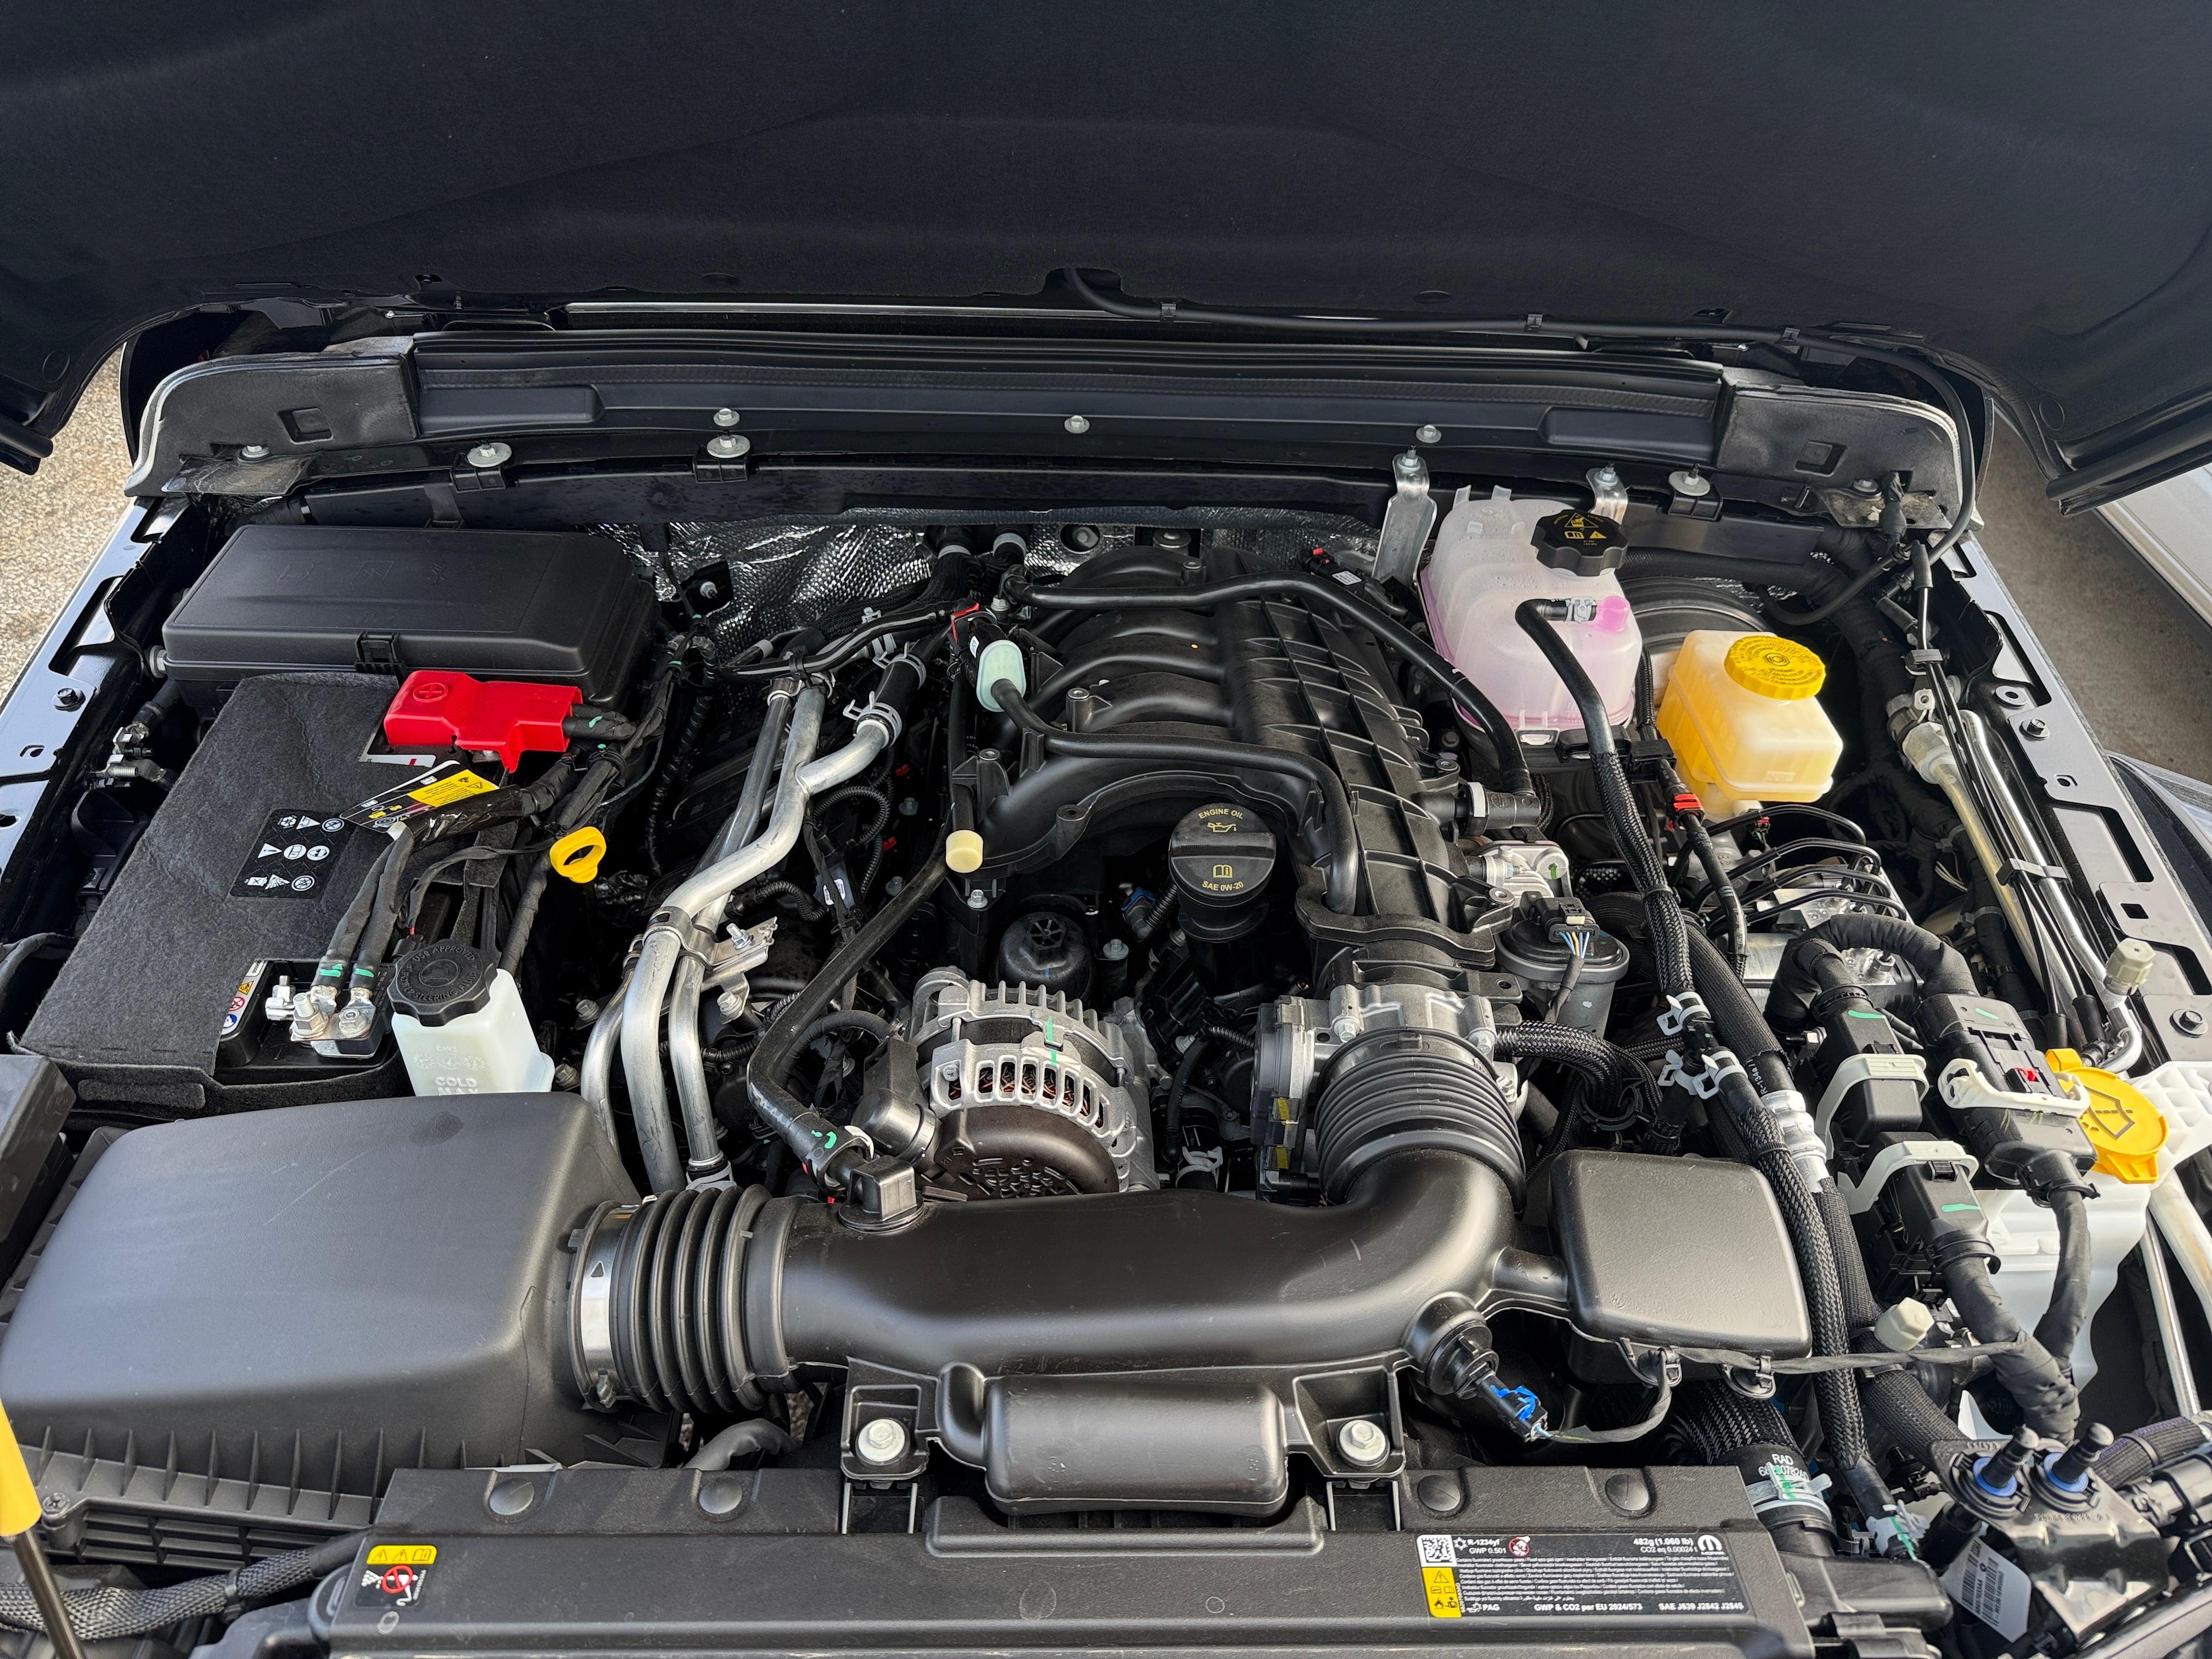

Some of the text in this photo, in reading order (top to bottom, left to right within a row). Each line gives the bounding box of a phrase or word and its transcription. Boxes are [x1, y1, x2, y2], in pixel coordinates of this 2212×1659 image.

[1198, 808, 1244, 819] ENGINE OIL
[1202, 881, 1244, 891] SAE 0W-20
[412, 945, 476, 961] USE APPROVED
[400, 972, 415, 995] POWER
[414, 990, 458, 1001] STEERING
[458, 971, 477, 991] FLUID
[435, 1076, 477, 1088] COLD
[1771, 1453, 1794, 1466] RAD
[1467, 1538, 1500, 1547] R-1234yf
[1681, 1537, 1694, 1547] lb)
